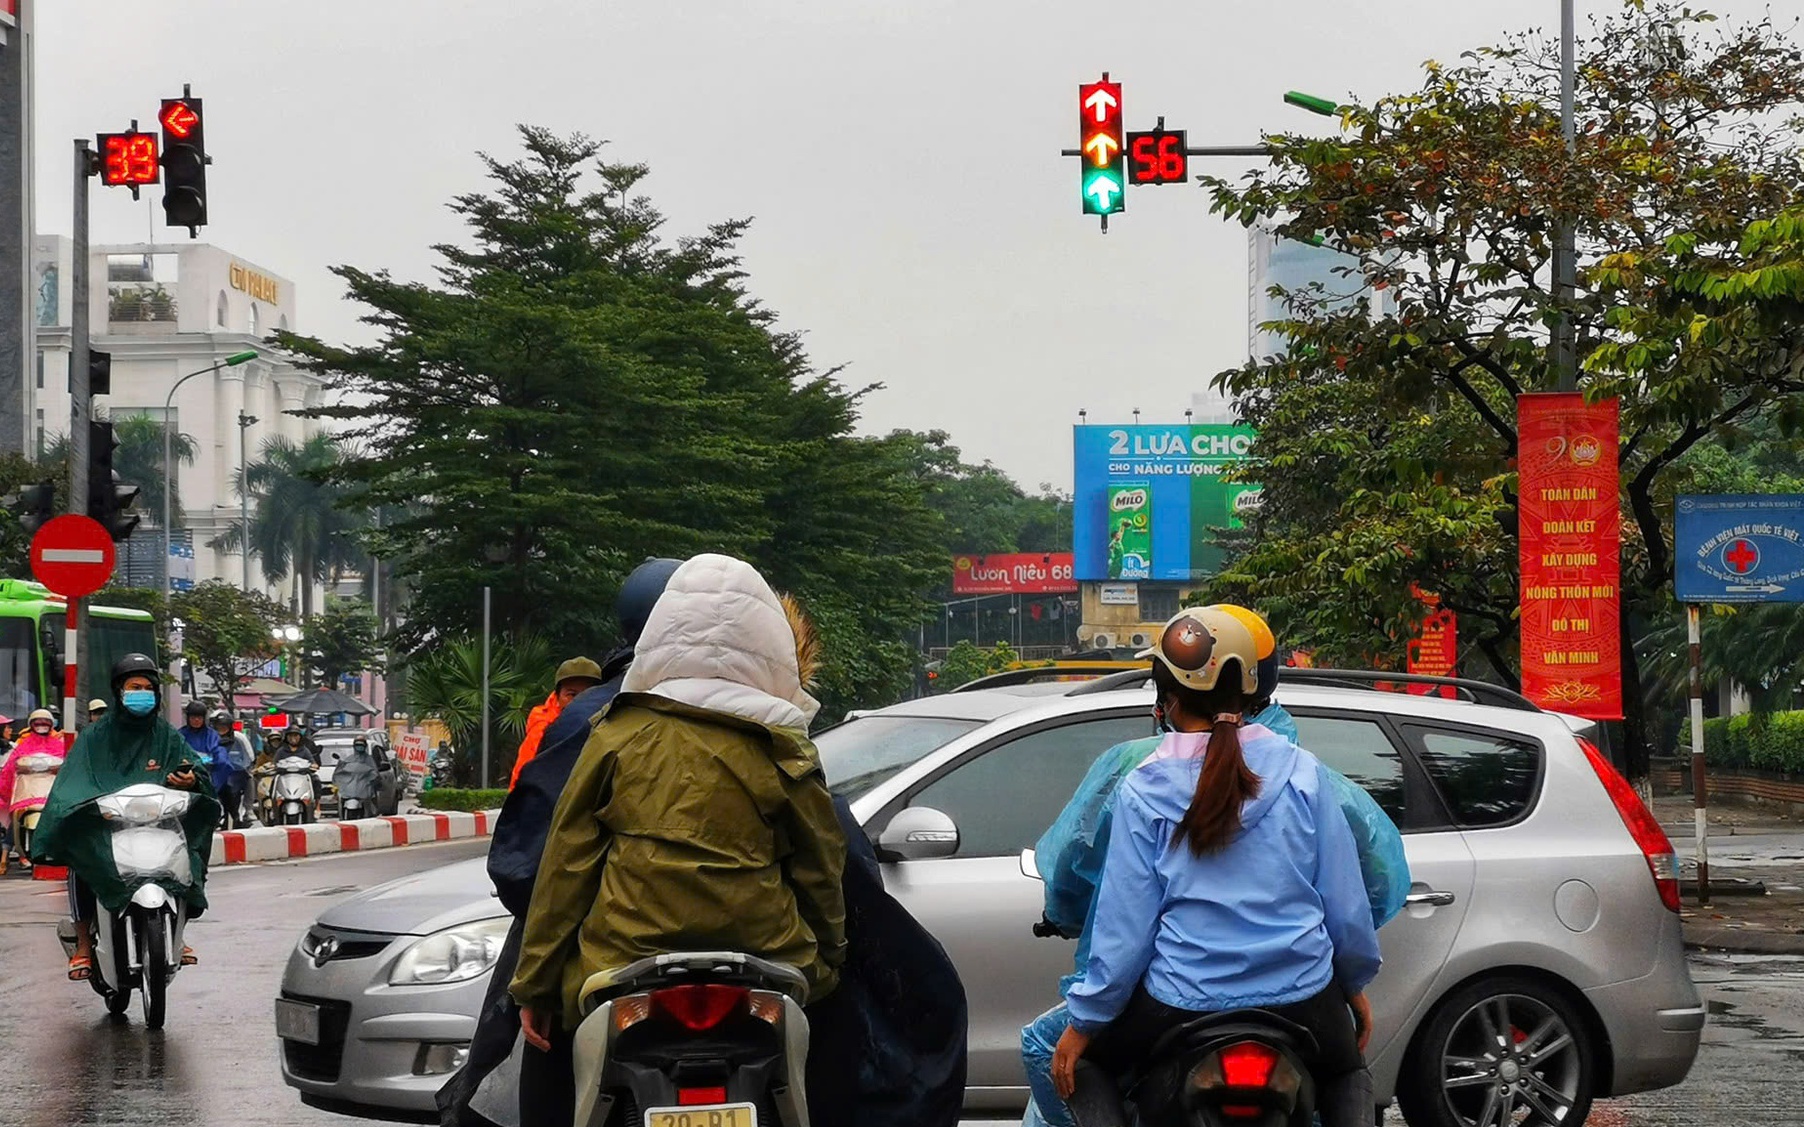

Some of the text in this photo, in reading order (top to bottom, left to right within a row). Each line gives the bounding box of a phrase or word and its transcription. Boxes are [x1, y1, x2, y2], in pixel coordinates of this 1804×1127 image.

[1132, 135, 1184, 181] 56
[1108, 430, 1129, 455] 2
[1191, 434, 1256, 461] CHỌ
[1108, 463, 1131, 472] CHO
[1134, 461, 1173, 475] NĂNG
[1115, 494, 1143, 507] MILO
[1752, 522, 1772, 535] QUỐC
[1542, 552, 1564, 567] XÂY
[1013, 563, 1046, 585] Niêu
[1051, 564, 1073, 580] 68
[1526, 584, 1557, 599] NÔNG
[1559, 584, 1590, 598] THÔN
[1570, 618, 1589, 634] THỊ
[1569, 650, 1599, 664] MINH
